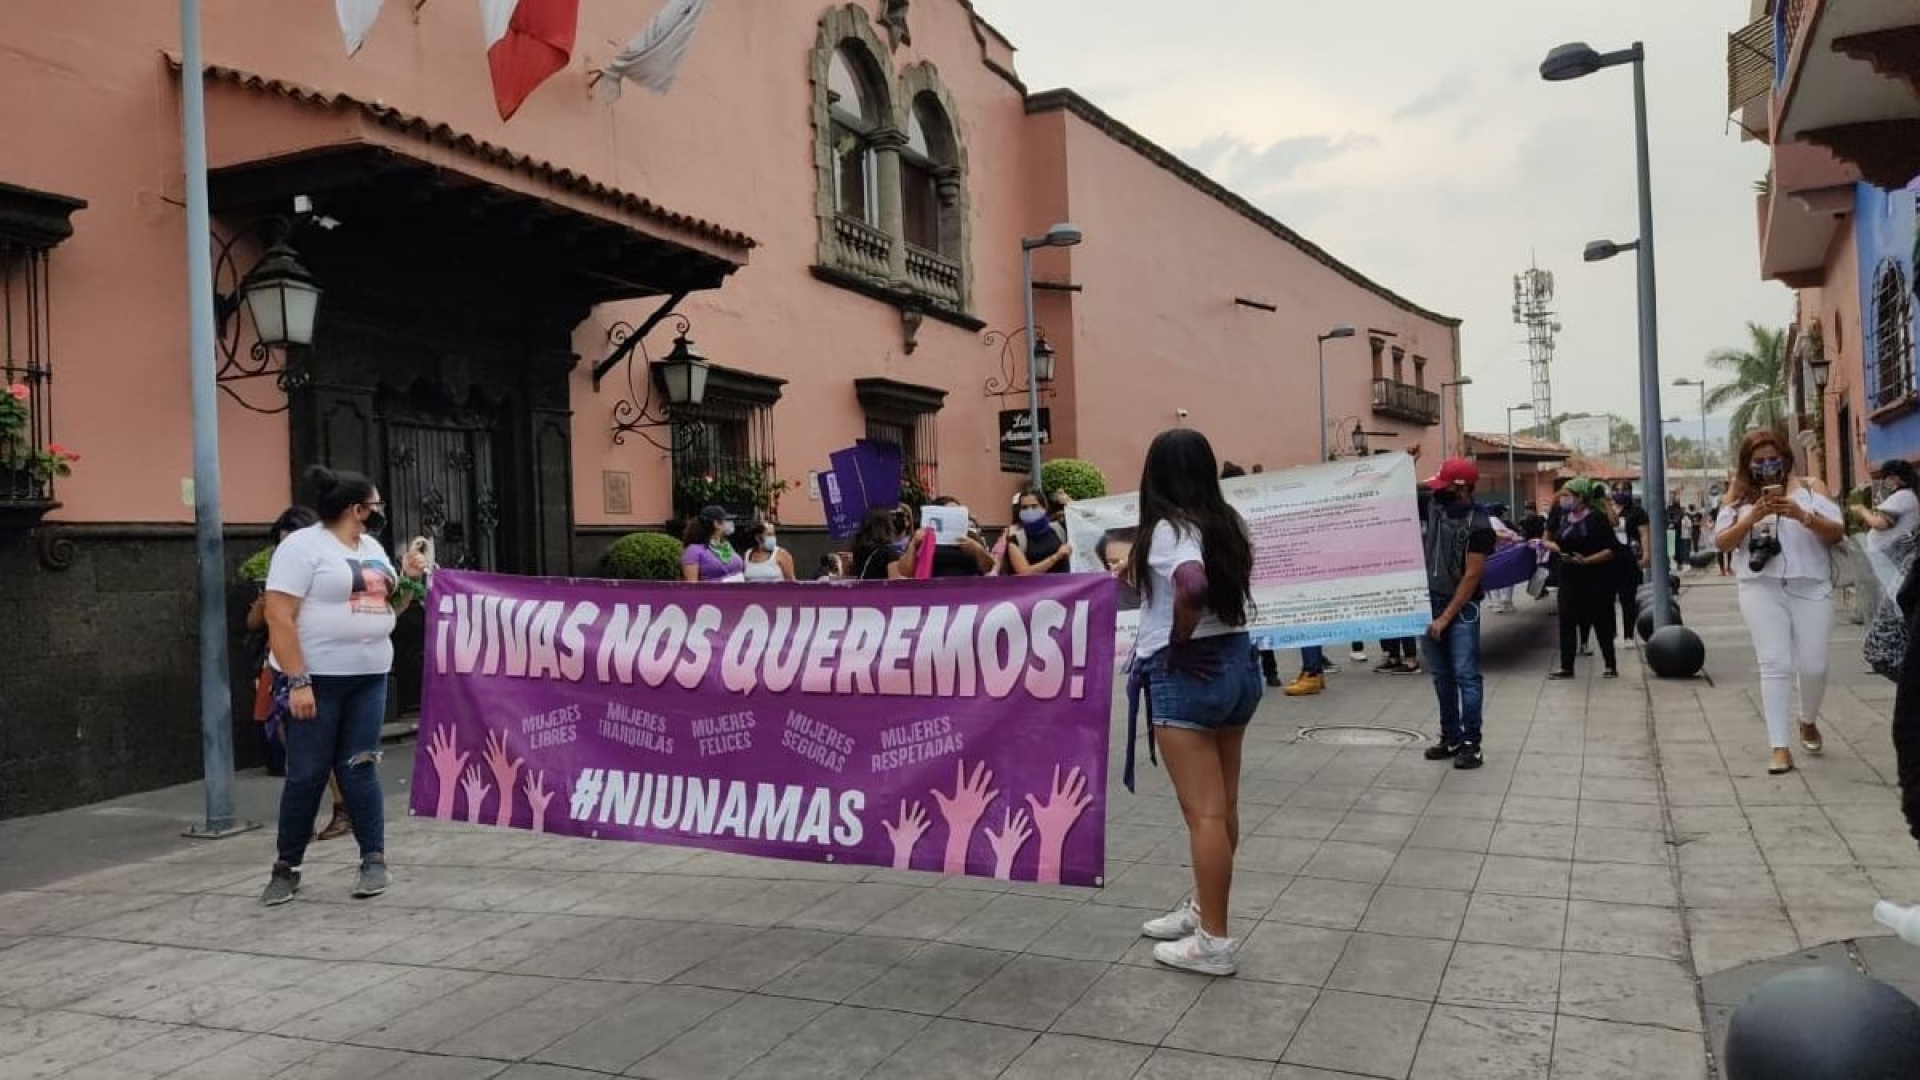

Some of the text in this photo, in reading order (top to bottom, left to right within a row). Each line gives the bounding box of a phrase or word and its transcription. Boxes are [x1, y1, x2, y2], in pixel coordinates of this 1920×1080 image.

[436, 594, 1089, 699] ¡VIVAS NOS QUEREMOS!
[522, 704, 581, 734] MUJERES
[607, 702, 667, 732] MUJERES
[691, 711, 756, 738] MUJERES
[786, 709, 855, 755] MUJERES
[880, 715, 951, 749] MUJERES
[530, 725, 577, 750] LIBRES
[599, 719, 676, 755] TRANQUILAS
[699, 731, 752, 758] FELICES
[780, 730, 844, 773] SEGURAS
[871, 732, 964, 773] RESPETADAS
[569, 767, 865, 847] #NIUNAMAS
